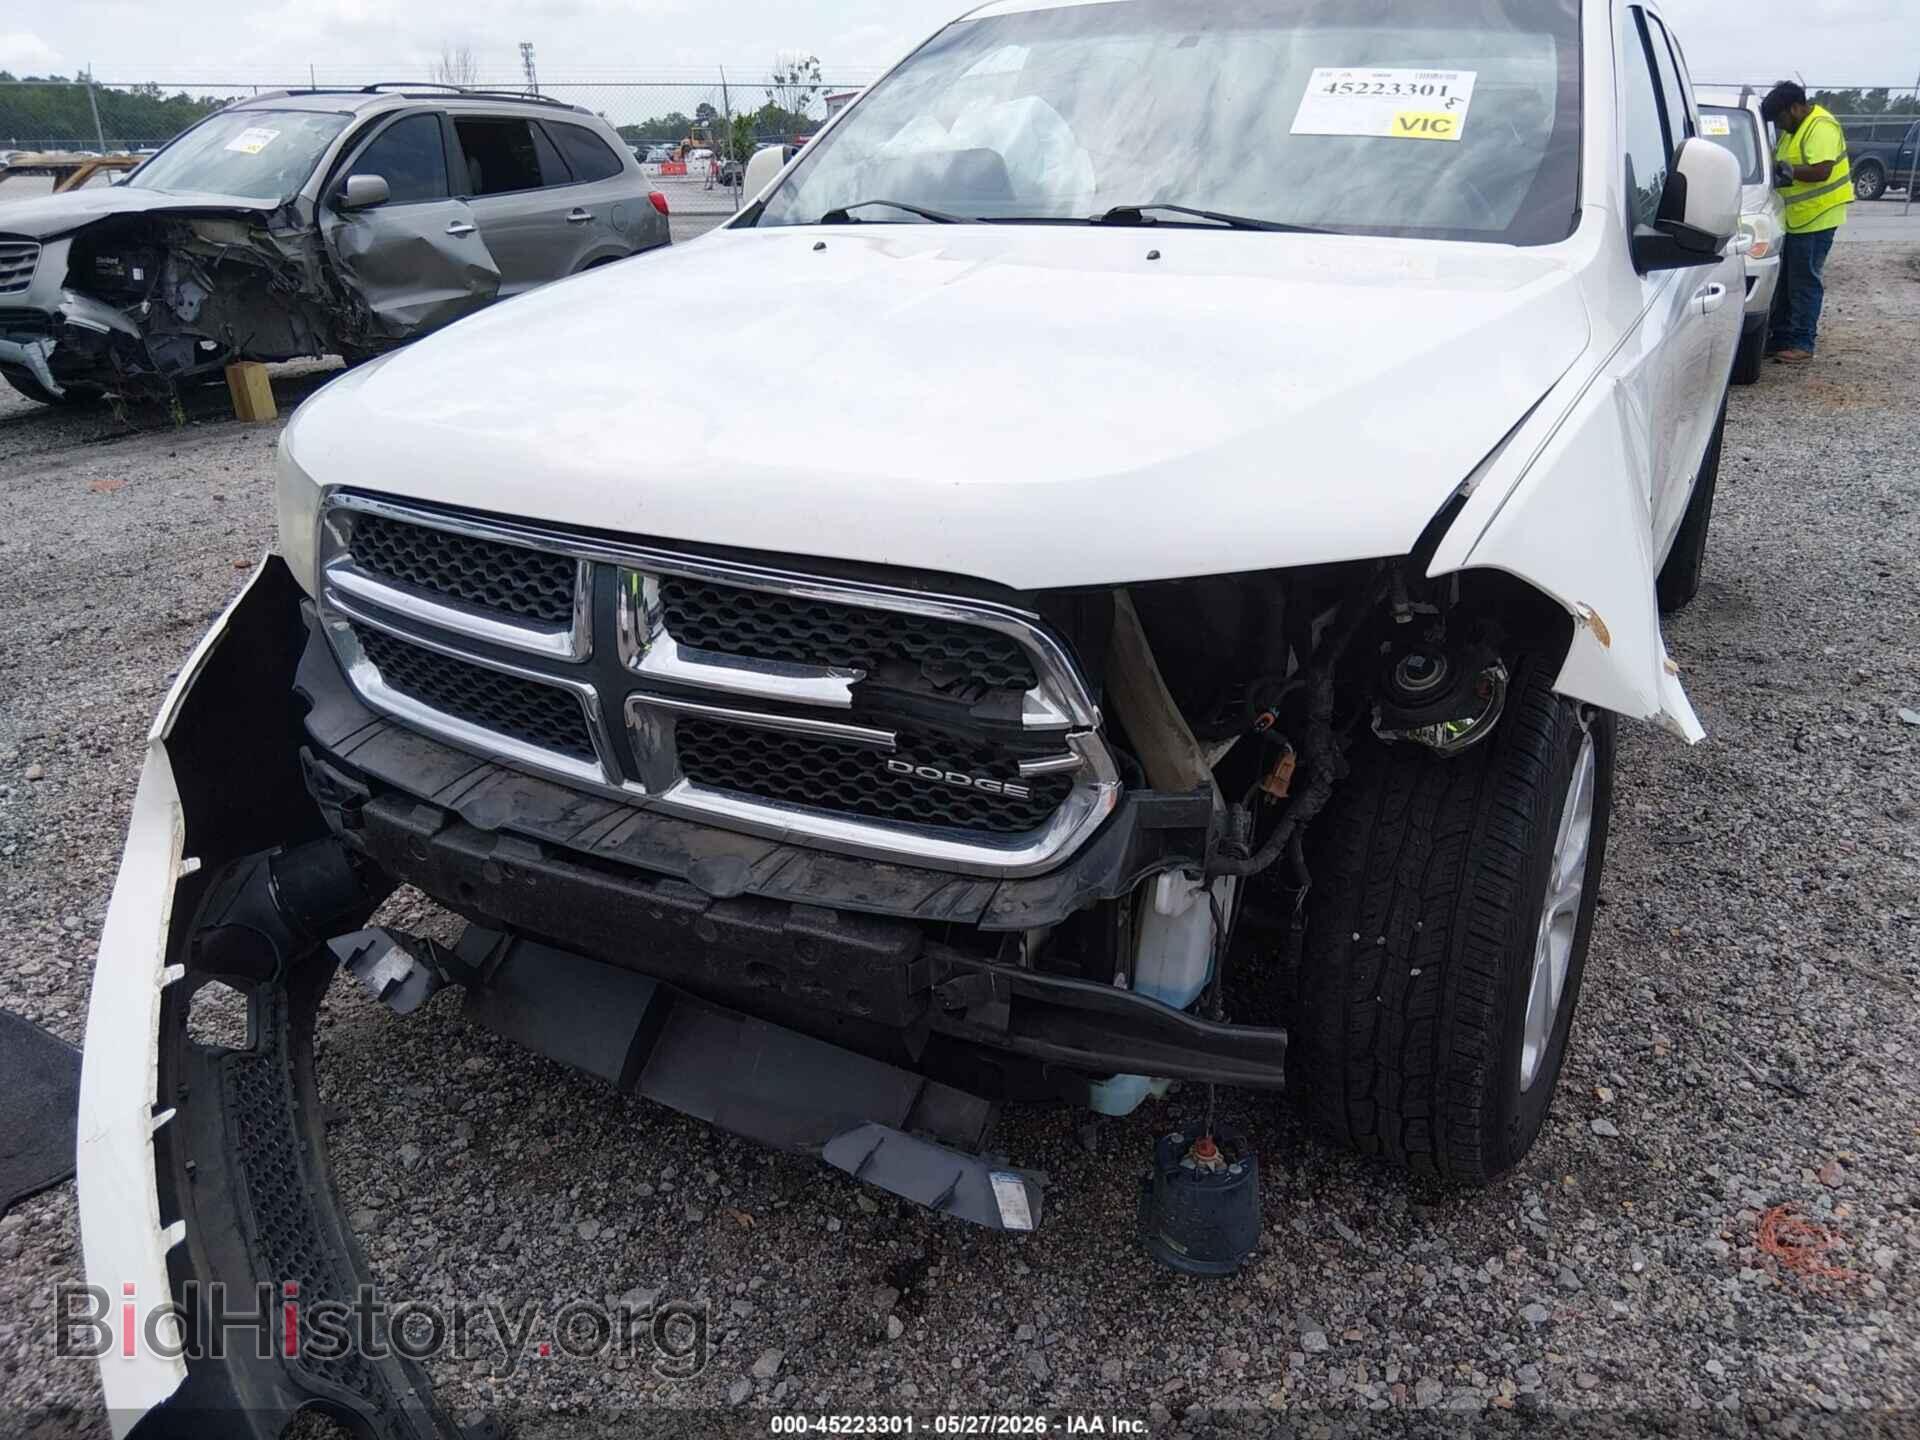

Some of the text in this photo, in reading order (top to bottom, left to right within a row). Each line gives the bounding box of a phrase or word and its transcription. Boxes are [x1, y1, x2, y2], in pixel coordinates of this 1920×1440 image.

[1323, 82, 1448, 97] 45223301
[1399, 117, 1452, 133] VIC
[888, 759, 1030, 799] DODGE
